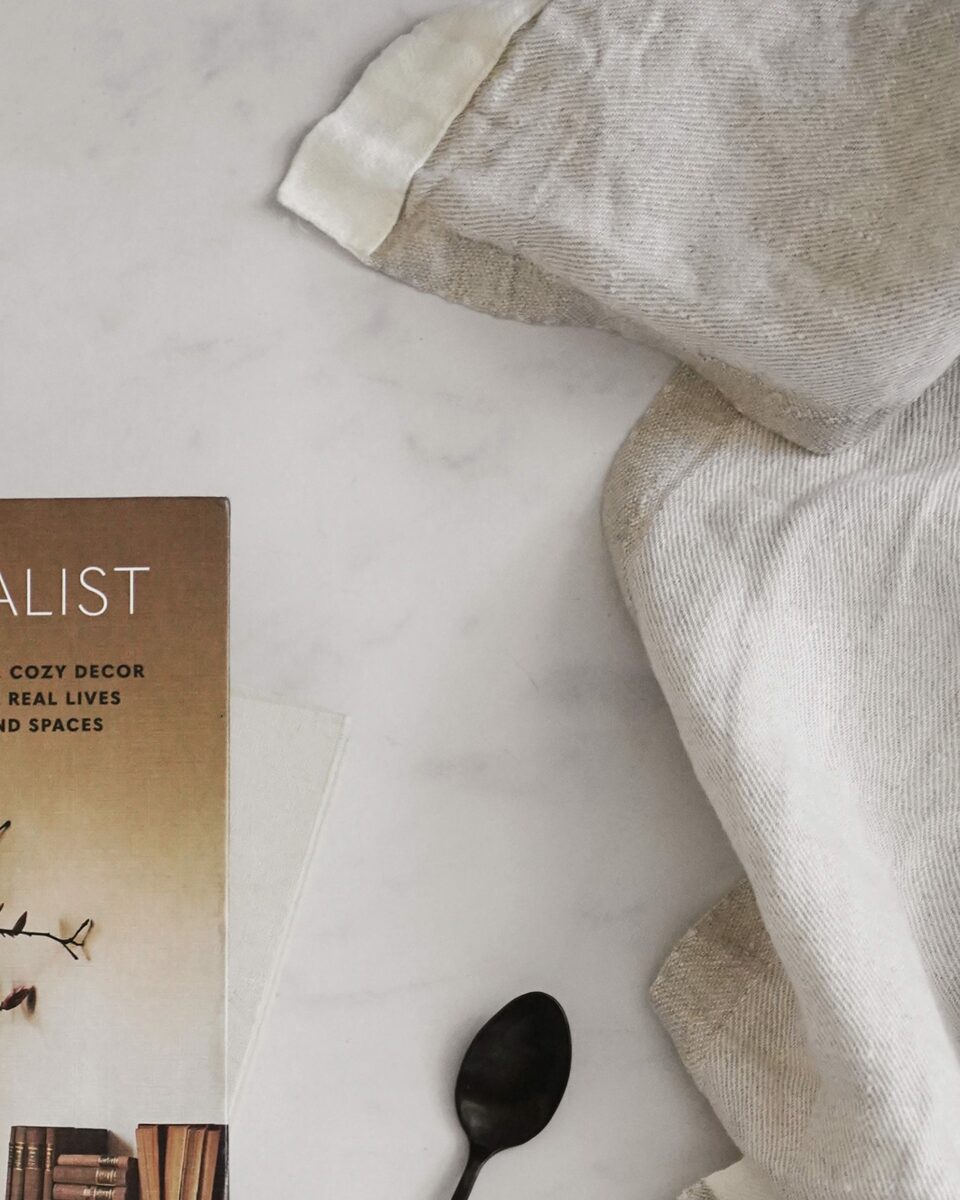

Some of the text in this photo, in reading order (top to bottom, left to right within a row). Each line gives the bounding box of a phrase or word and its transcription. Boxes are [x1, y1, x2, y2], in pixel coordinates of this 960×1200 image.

[9, 664, 67, 680] COZY
[74, 663, 145, 679] DECOR
[8, 691, 58, 706] REAL
[65, 690, 121, 706] LIVES
[28, 717, 104, 733] SPACES
